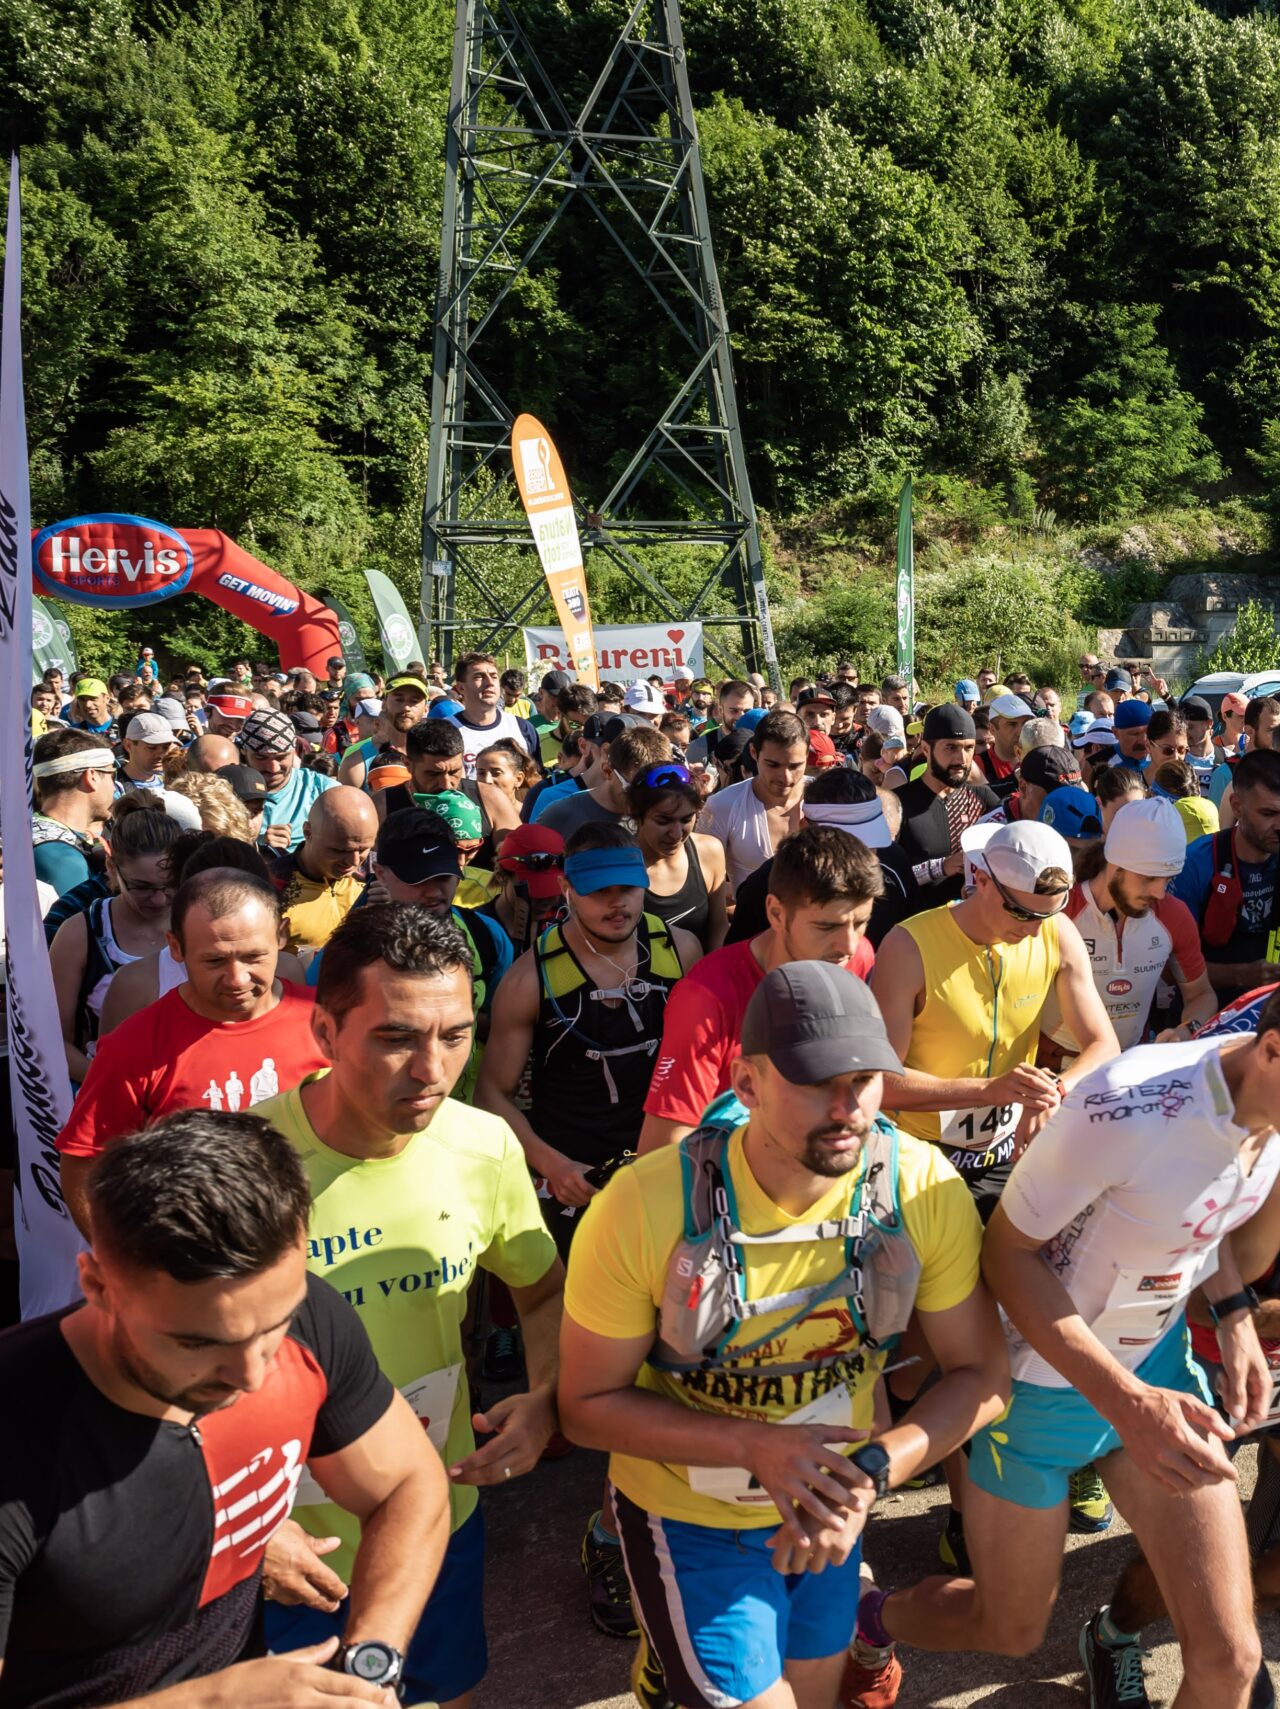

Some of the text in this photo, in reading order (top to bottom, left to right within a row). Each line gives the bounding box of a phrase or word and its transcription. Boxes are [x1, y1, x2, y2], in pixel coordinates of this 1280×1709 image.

[51, 536, 181, 582] Hervis
[218, 572, 249, 597] GET
[958, 1103, 1013, 1141] 148
[377, 1241, 474, 1297] vorbe!
